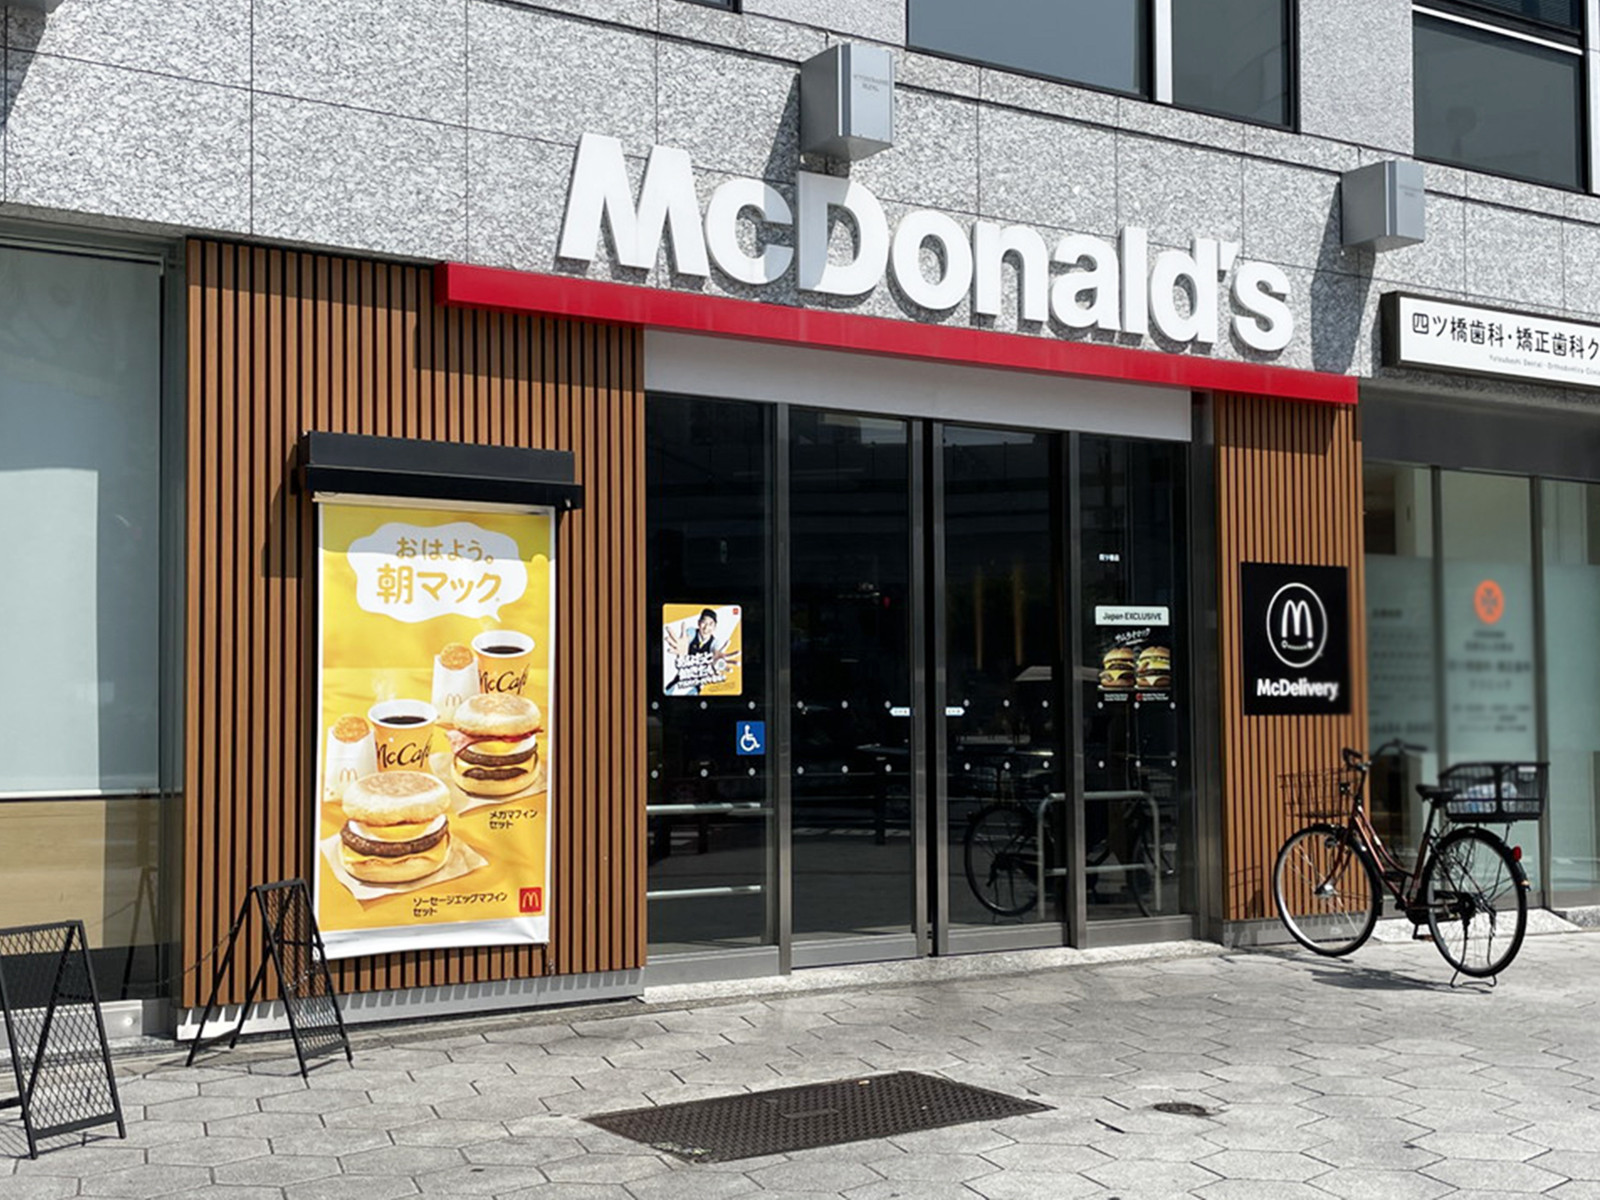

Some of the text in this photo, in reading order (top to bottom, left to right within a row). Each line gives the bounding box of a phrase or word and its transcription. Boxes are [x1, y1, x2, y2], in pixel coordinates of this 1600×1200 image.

[558, 132, 1294, 351] McDonald's
[396, 537, 494, 564] おはよう。
[376, 563, 502, 604] 朝マック
[1102, 612, 1162, 622] Japan EXCLUSIVE
[1256, 677, 1340, 702] McDelivery
